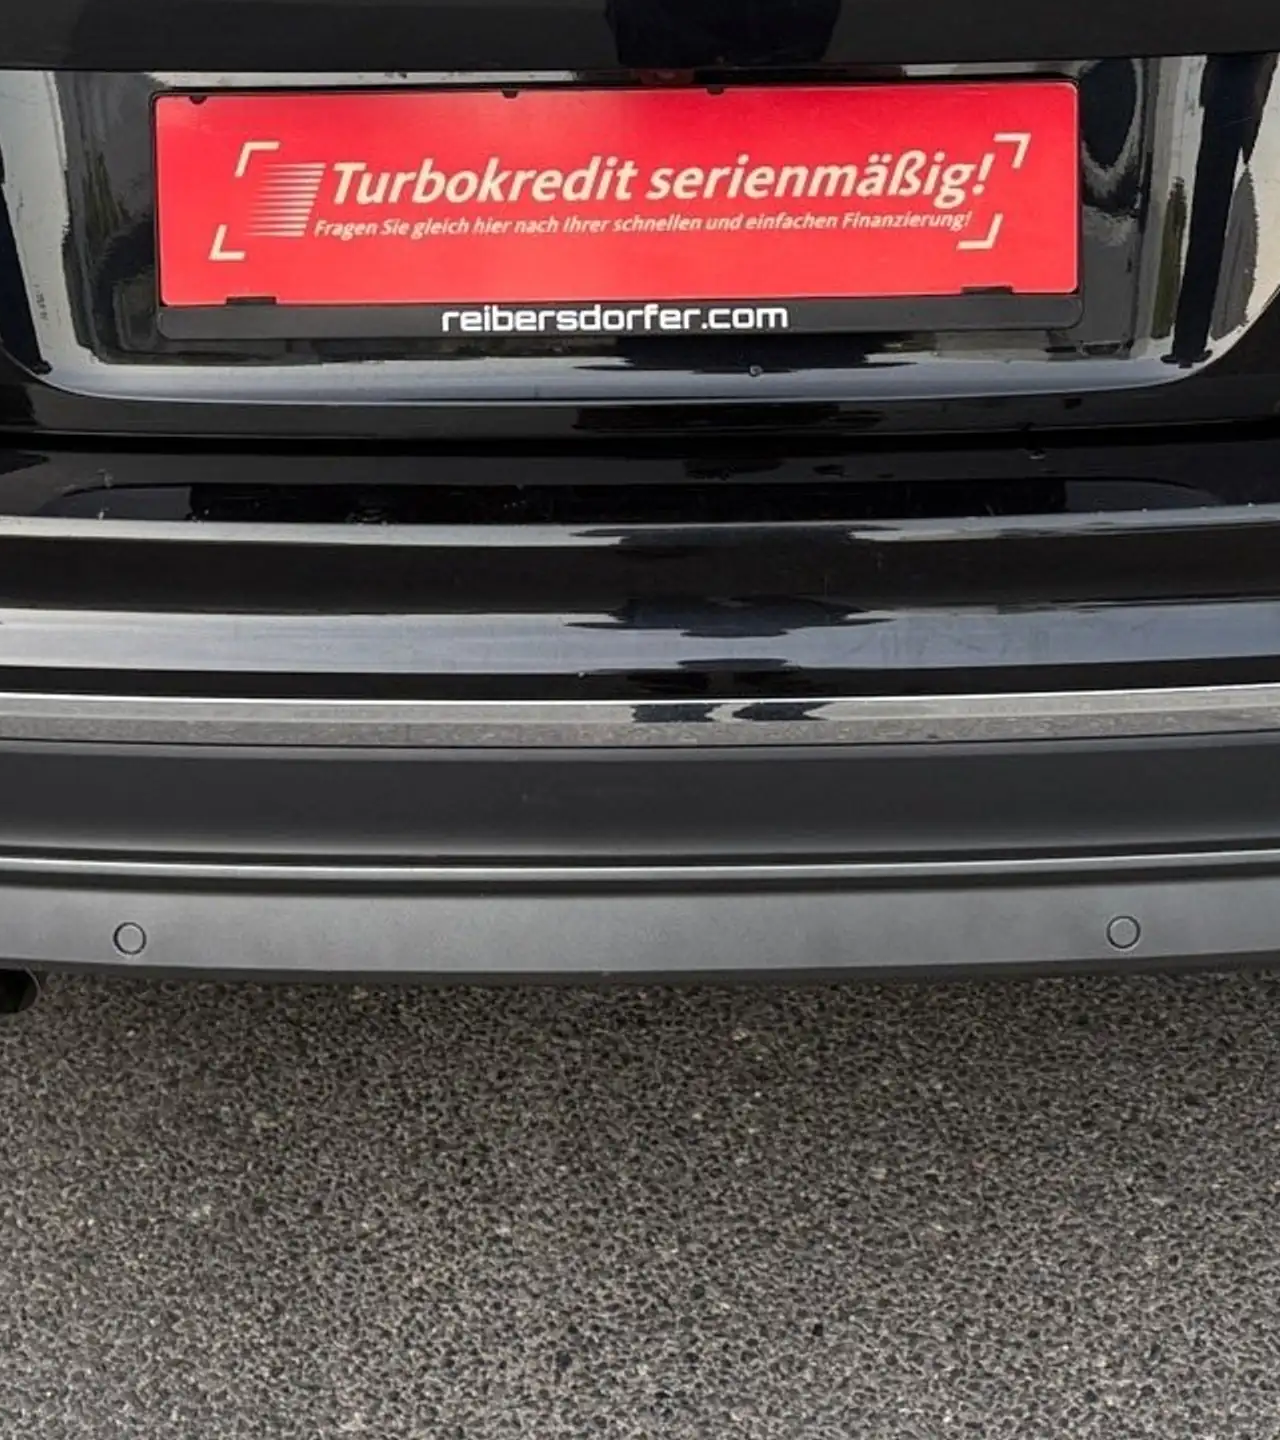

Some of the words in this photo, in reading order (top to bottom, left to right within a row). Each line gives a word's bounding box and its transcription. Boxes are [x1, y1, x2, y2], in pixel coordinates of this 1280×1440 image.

[332, 156, 638, 205] Turbokredit
[645, 149, 996, 210] serienmäßig!
[315, 217, 377, 241] Fragen
[382, 218, 409, 236] Sie
[411, 216, 470, 240] gleich
[473, 216, 511, 235] hier
[514, 216, 558, 234] nach
[563, 215, 608, 234] Ihrer
[614, 213, 701, 232] schnellen
[705, 213, 742, 231] und
[745, 212, 838, 230] einfachen
[842, 210, 972, 233] Finanzierung!
[441, 304, 789, 332] reibersdorfer.com
